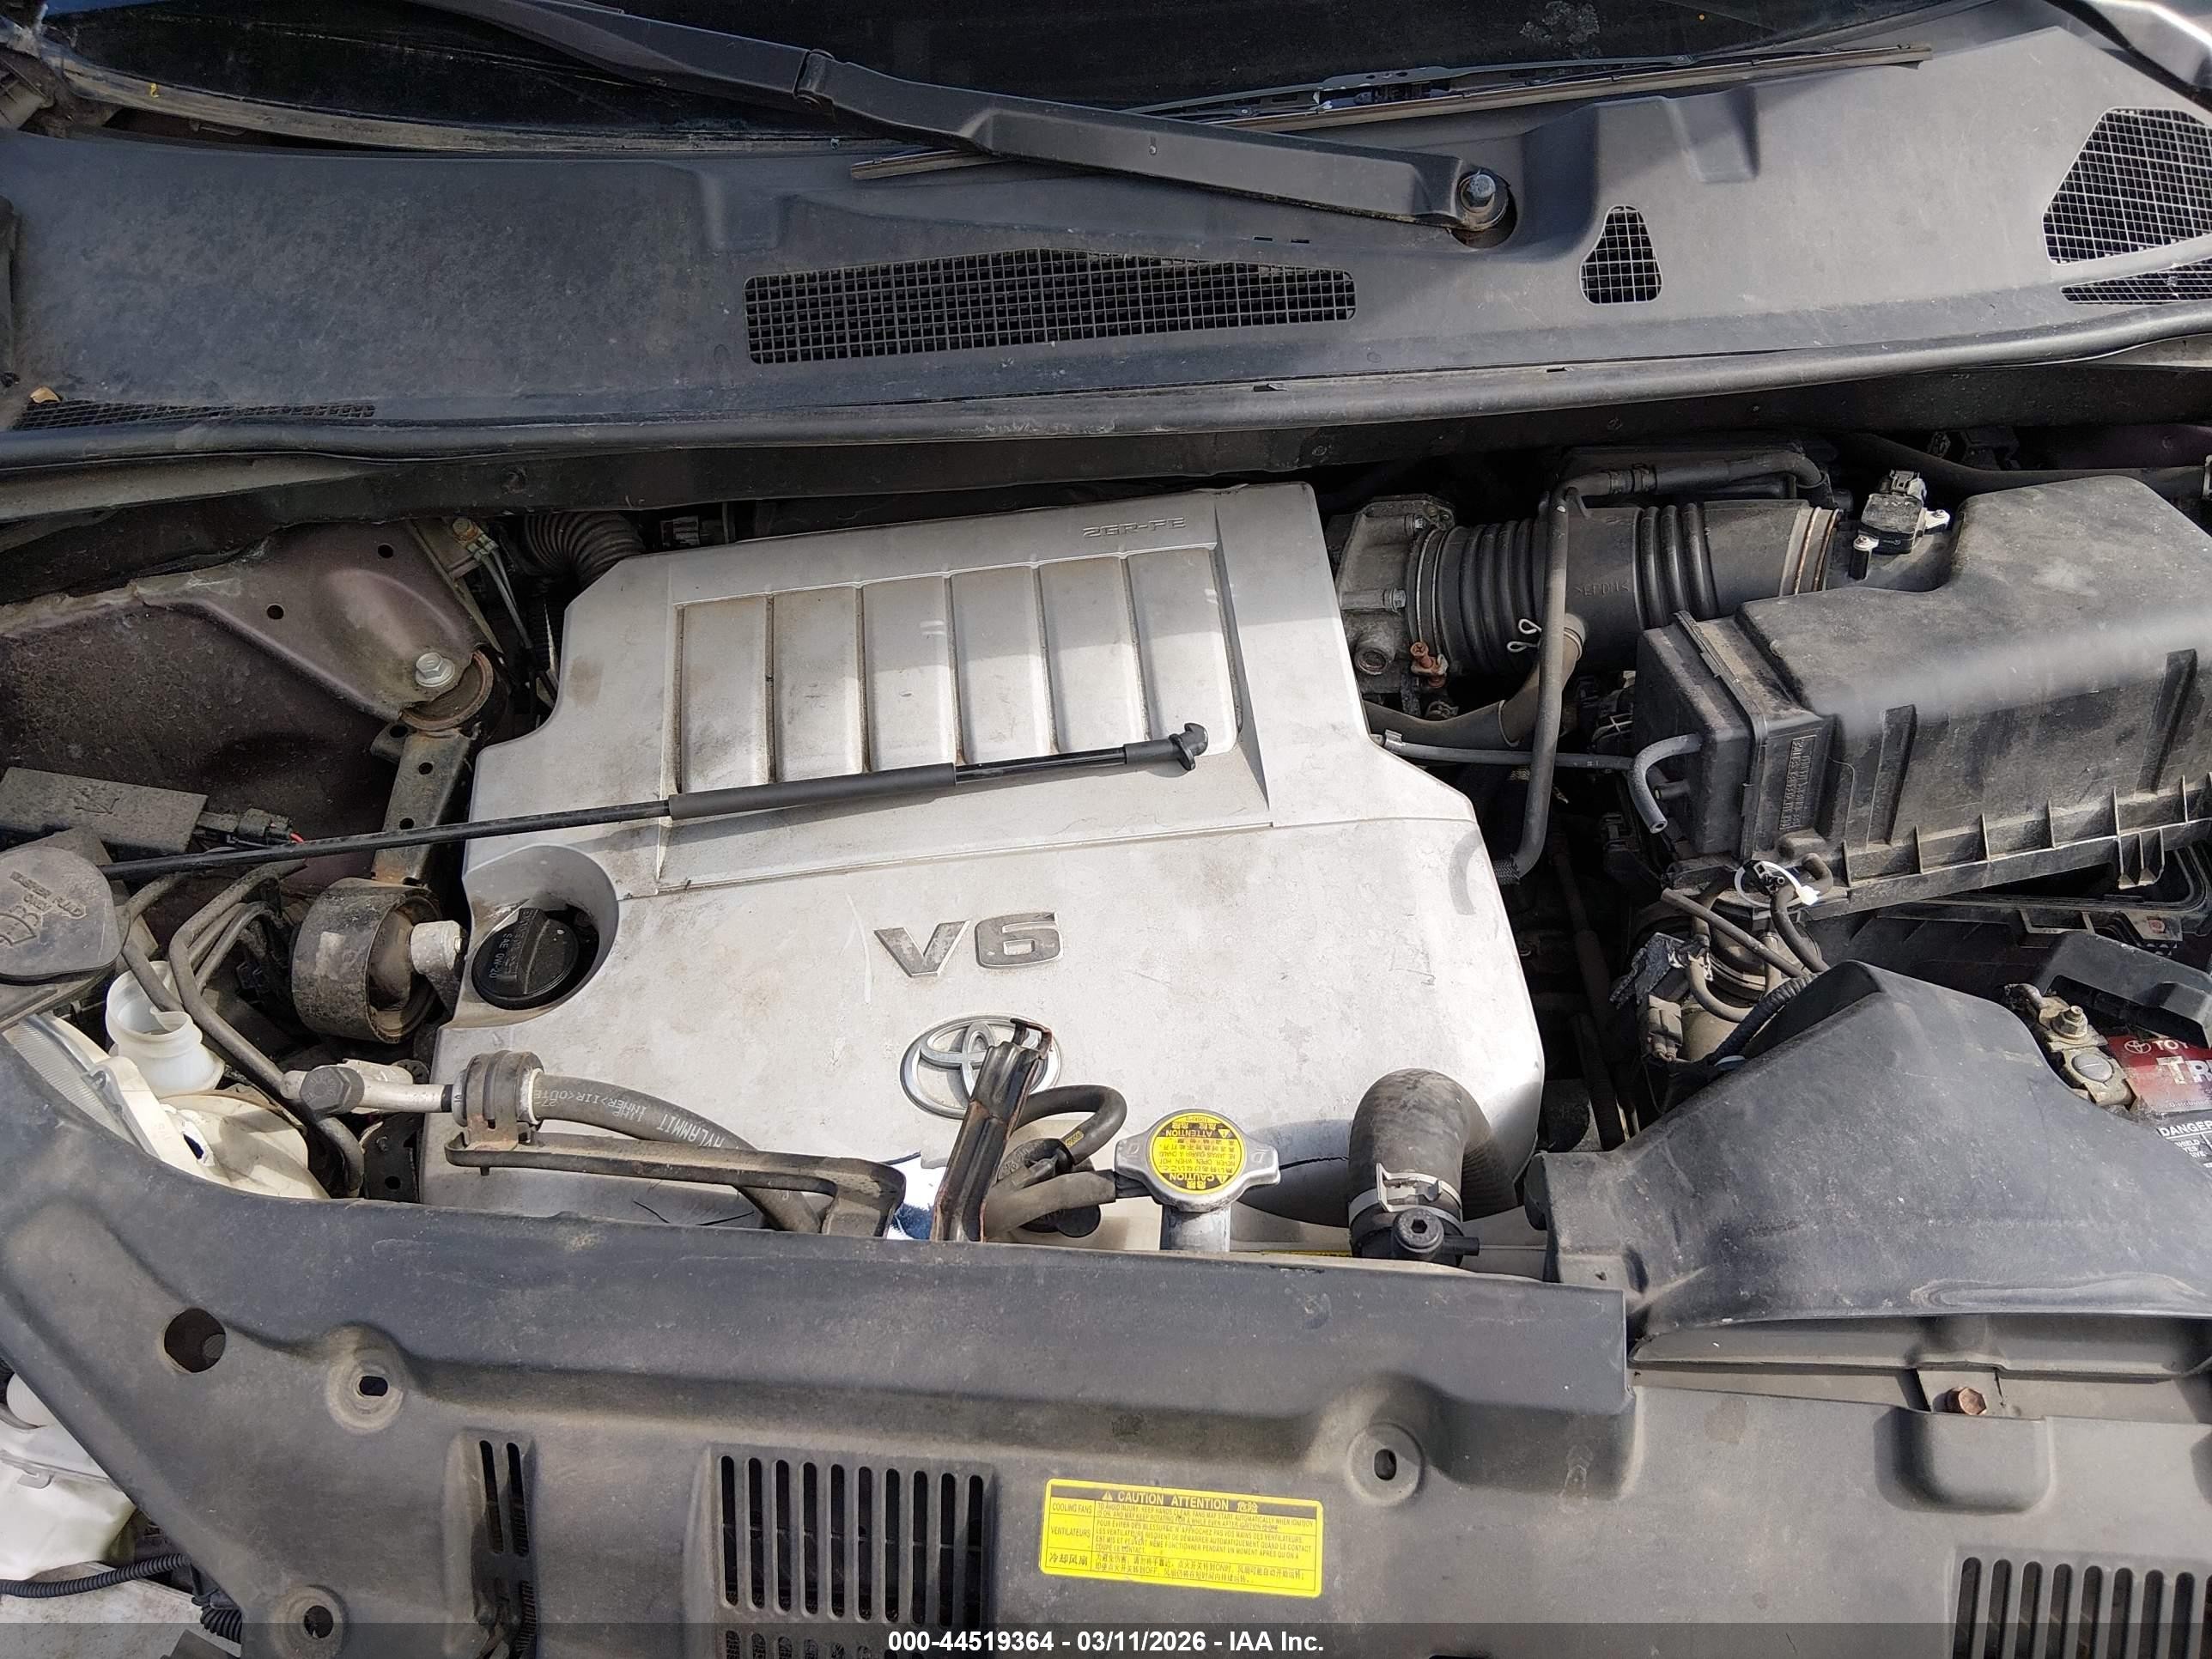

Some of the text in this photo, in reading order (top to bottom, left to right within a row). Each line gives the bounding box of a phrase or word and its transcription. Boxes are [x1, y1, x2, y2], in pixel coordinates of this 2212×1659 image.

[1082, 517, 1186, 538] 2GR-FE
[874, 912, 1065, 977] V6
[2156, 1056, 2212, 1085] TR
[1169, 1172, 1214, 1181] CAUTION
[1052, 1503, 1092, 1513] COOLING FANS
[1117, 1491, 1229, 1510] CAUTION ATTENTION
[1049, 1526, 1091, 1538] VENTILATEURS
